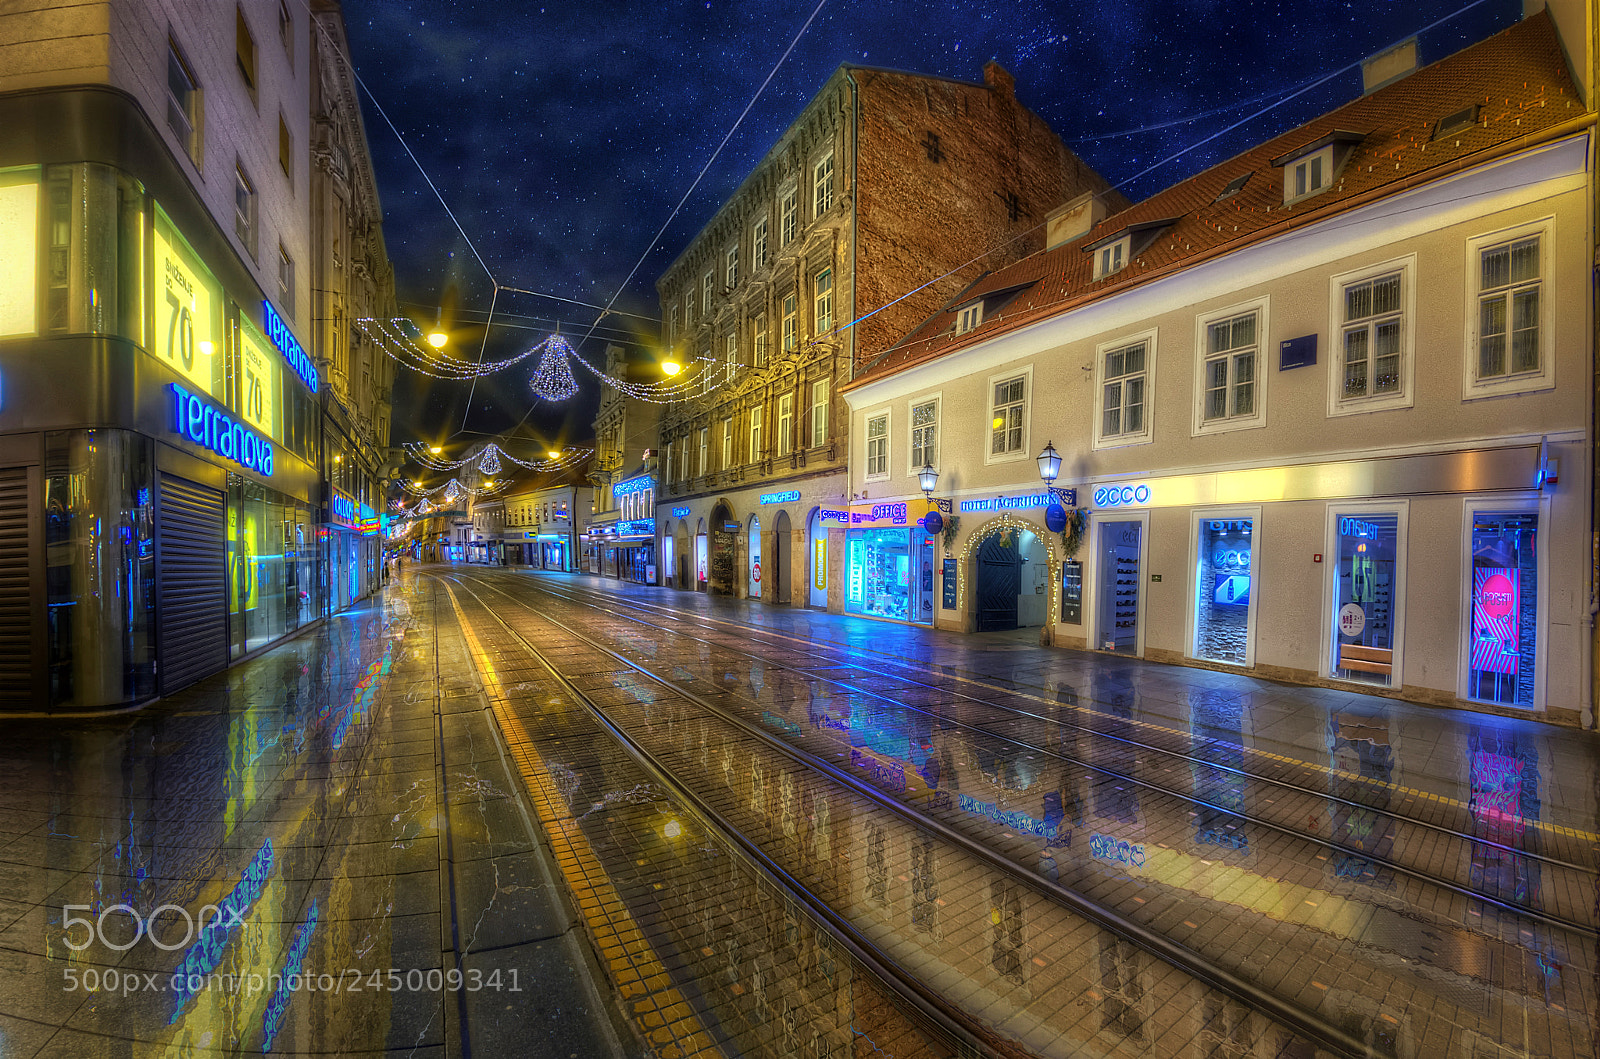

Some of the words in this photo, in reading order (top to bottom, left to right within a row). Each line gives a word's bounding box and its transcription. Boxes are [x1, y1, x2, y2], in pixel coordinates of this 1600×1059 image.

[166, 257, 193, 298] SNIŽENJE
[166, 287, 193, 372] 70
[263, 300, 318, 393] Terranova
[246, 367, 262, 424] 70
[172, 383, 274, 477] Terranova
[760, 490, 800, 505] SPRINGFIELD
[873, 503, 906, 519] OFFICE
[961, 499, 991, 512] HOTEL
[1095, 484, 1151, 507] ecco
